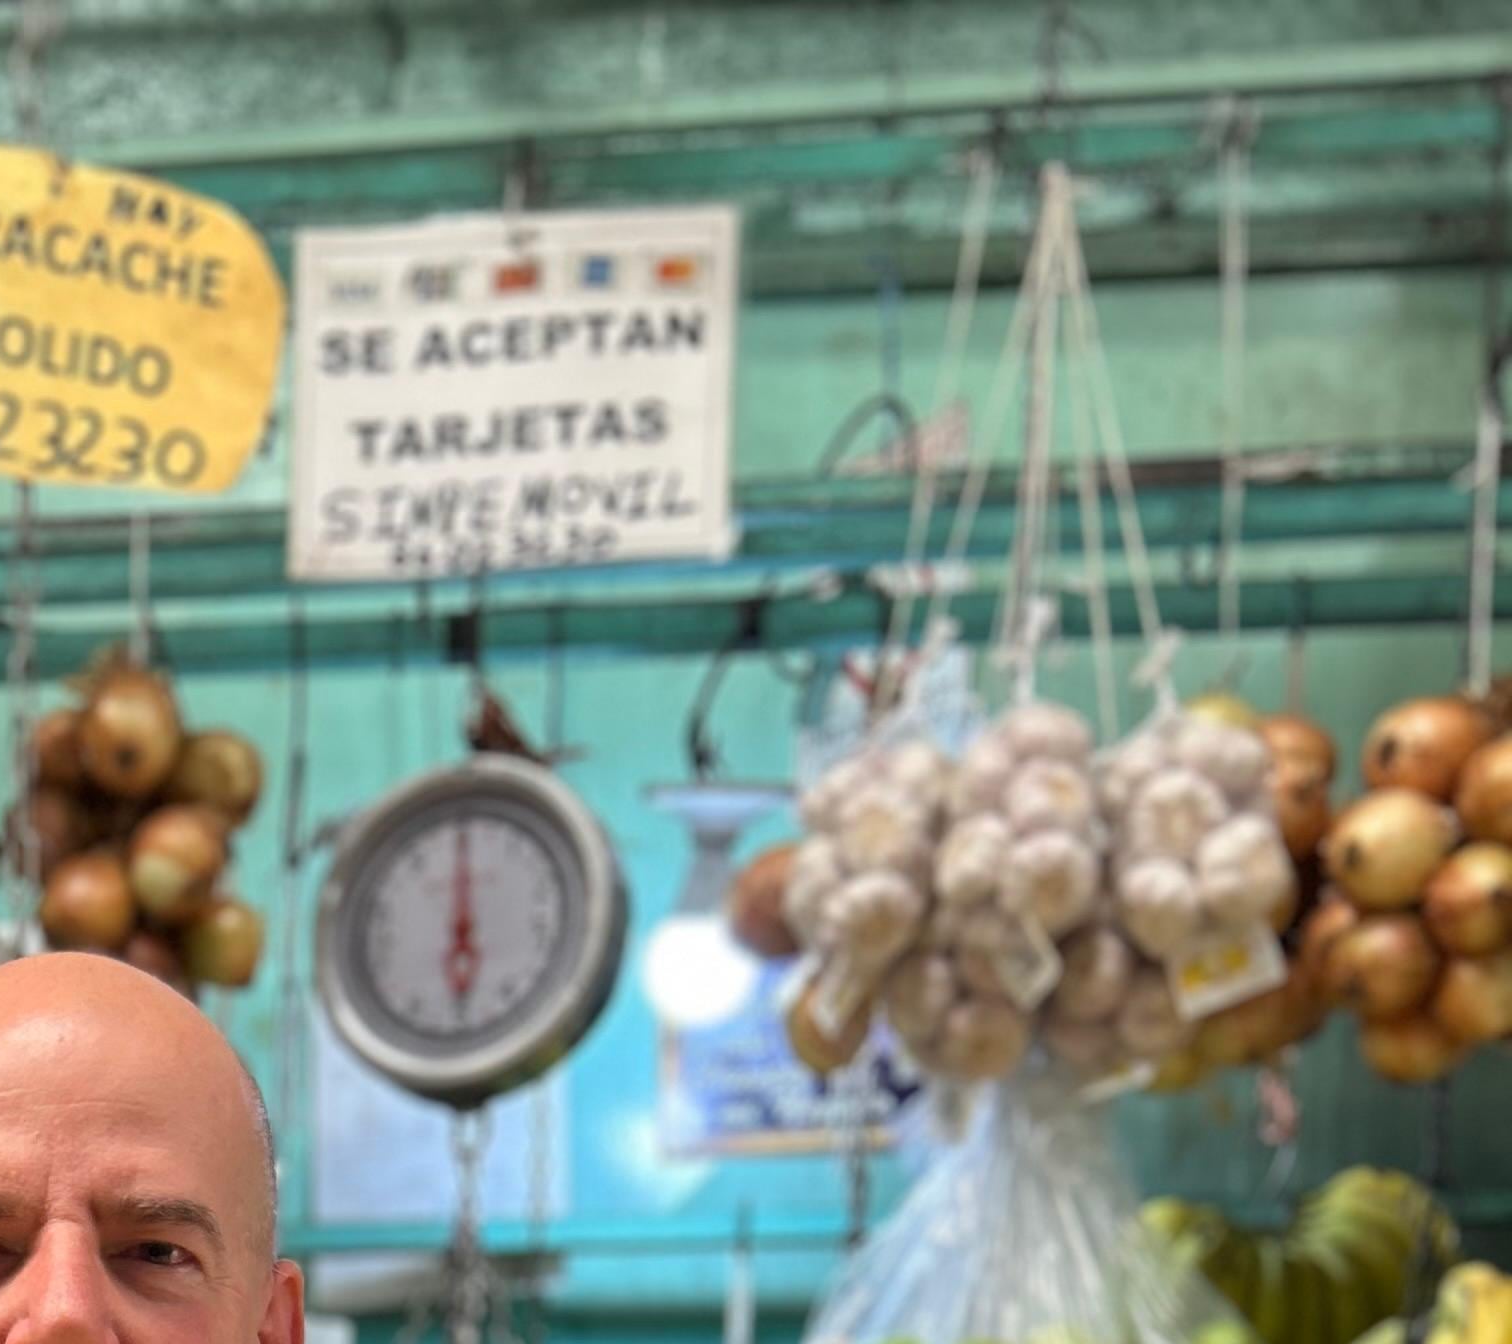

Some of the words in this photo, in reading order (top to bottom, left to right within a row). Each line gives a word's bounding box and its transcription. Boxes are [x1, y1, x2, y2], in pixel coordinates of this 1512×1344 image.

[320, 327, 394, 376] SE
[414, 309, 707, 371] ACEPTAN
[351, 398, 669, 466] TARJETAS
